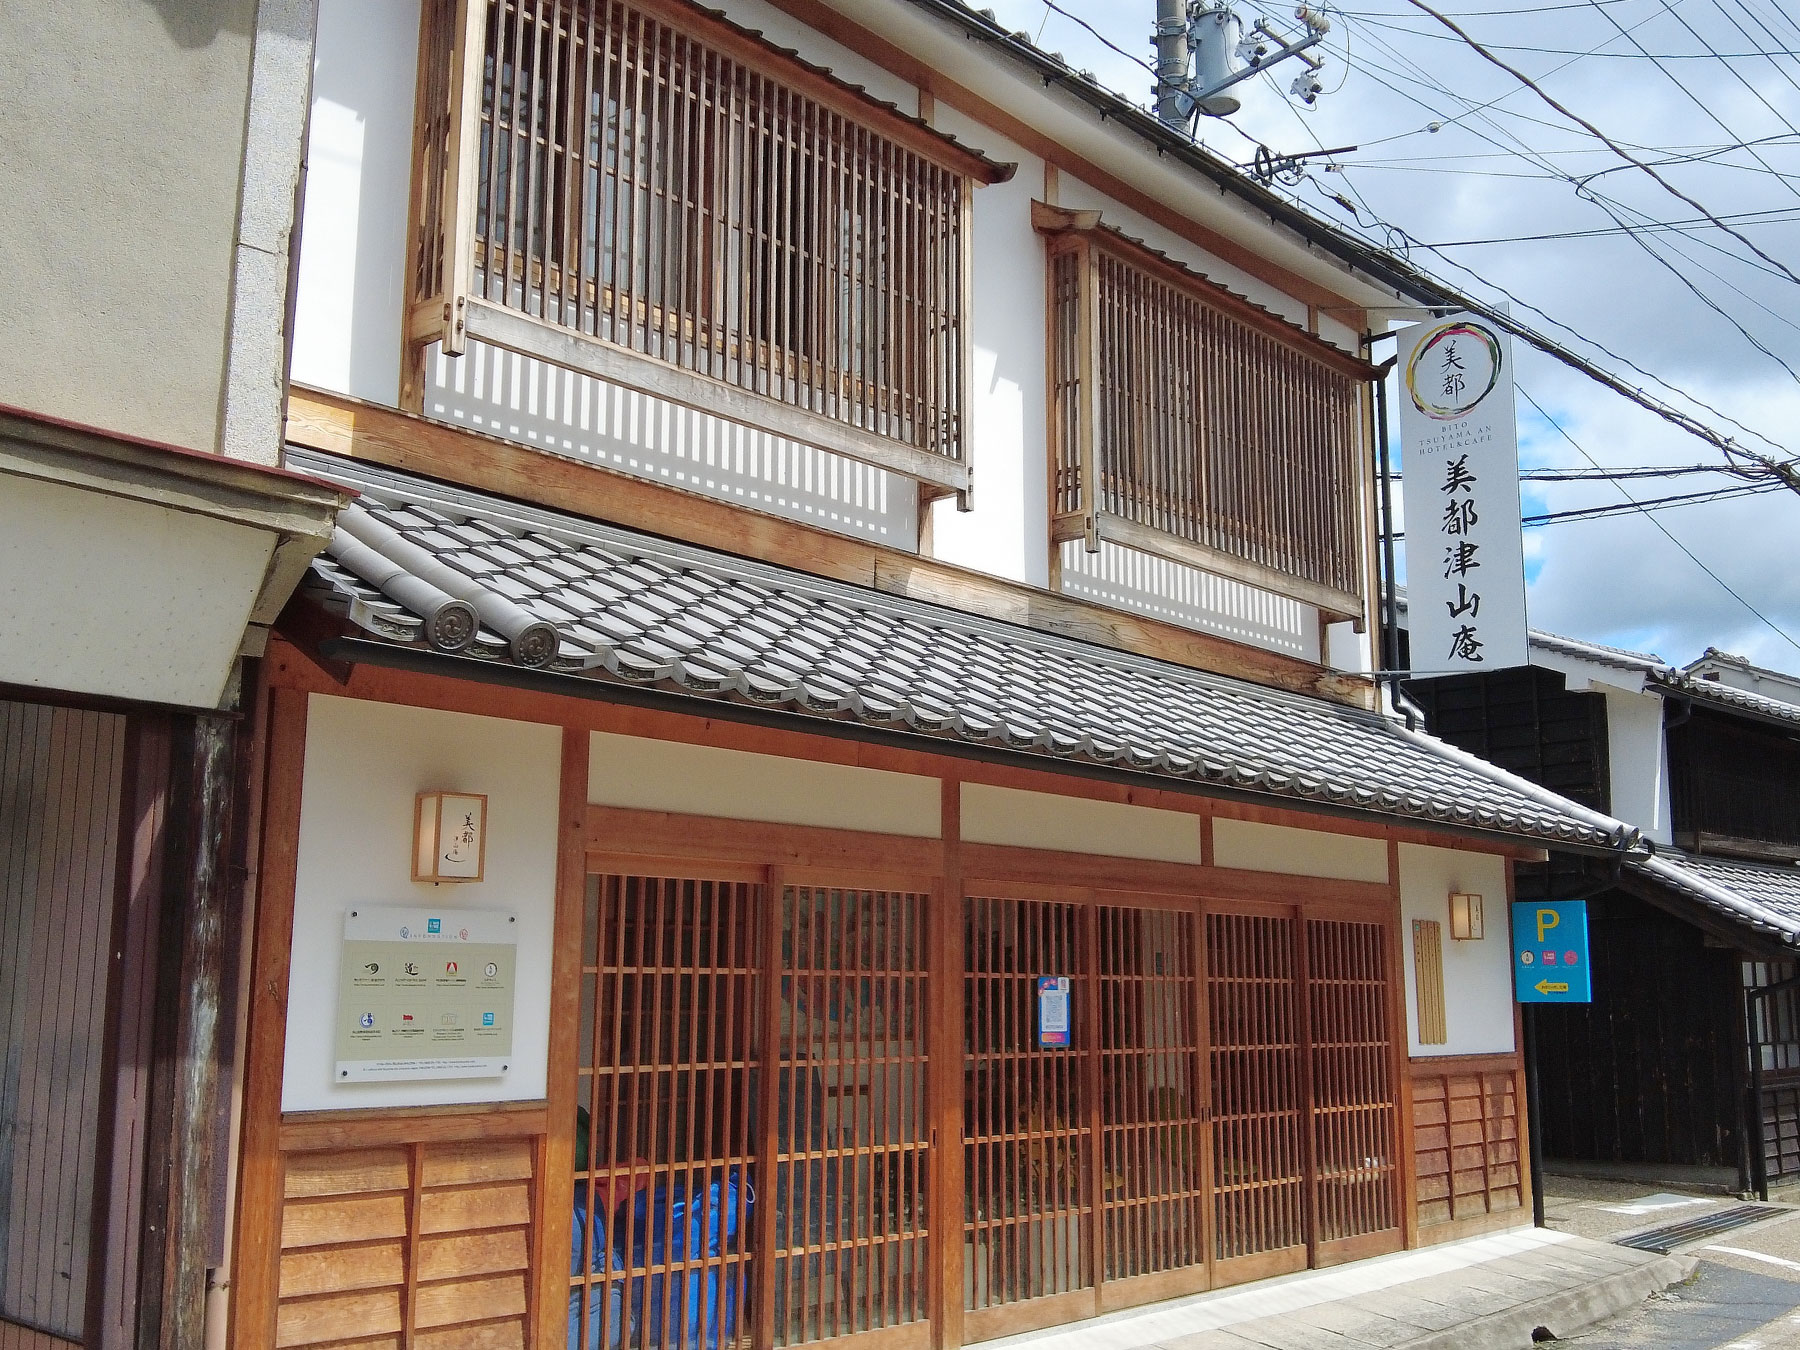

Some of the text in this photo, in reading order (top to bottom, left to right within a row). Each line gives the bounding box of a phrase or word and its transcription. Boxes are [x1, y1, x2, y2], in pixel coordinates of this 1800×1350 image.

[1440, 339, 1466, 404] 美都
[1419, 425, 1493, 446] TSUYAMA AN
[1441, 421, 1468, 432] BITO
[1419, 434, 1493, 455] HOTEL&CAFE
[1440, 453, 1484, 662] 美都津山庵
[1536, 909, 1560, 942] P
